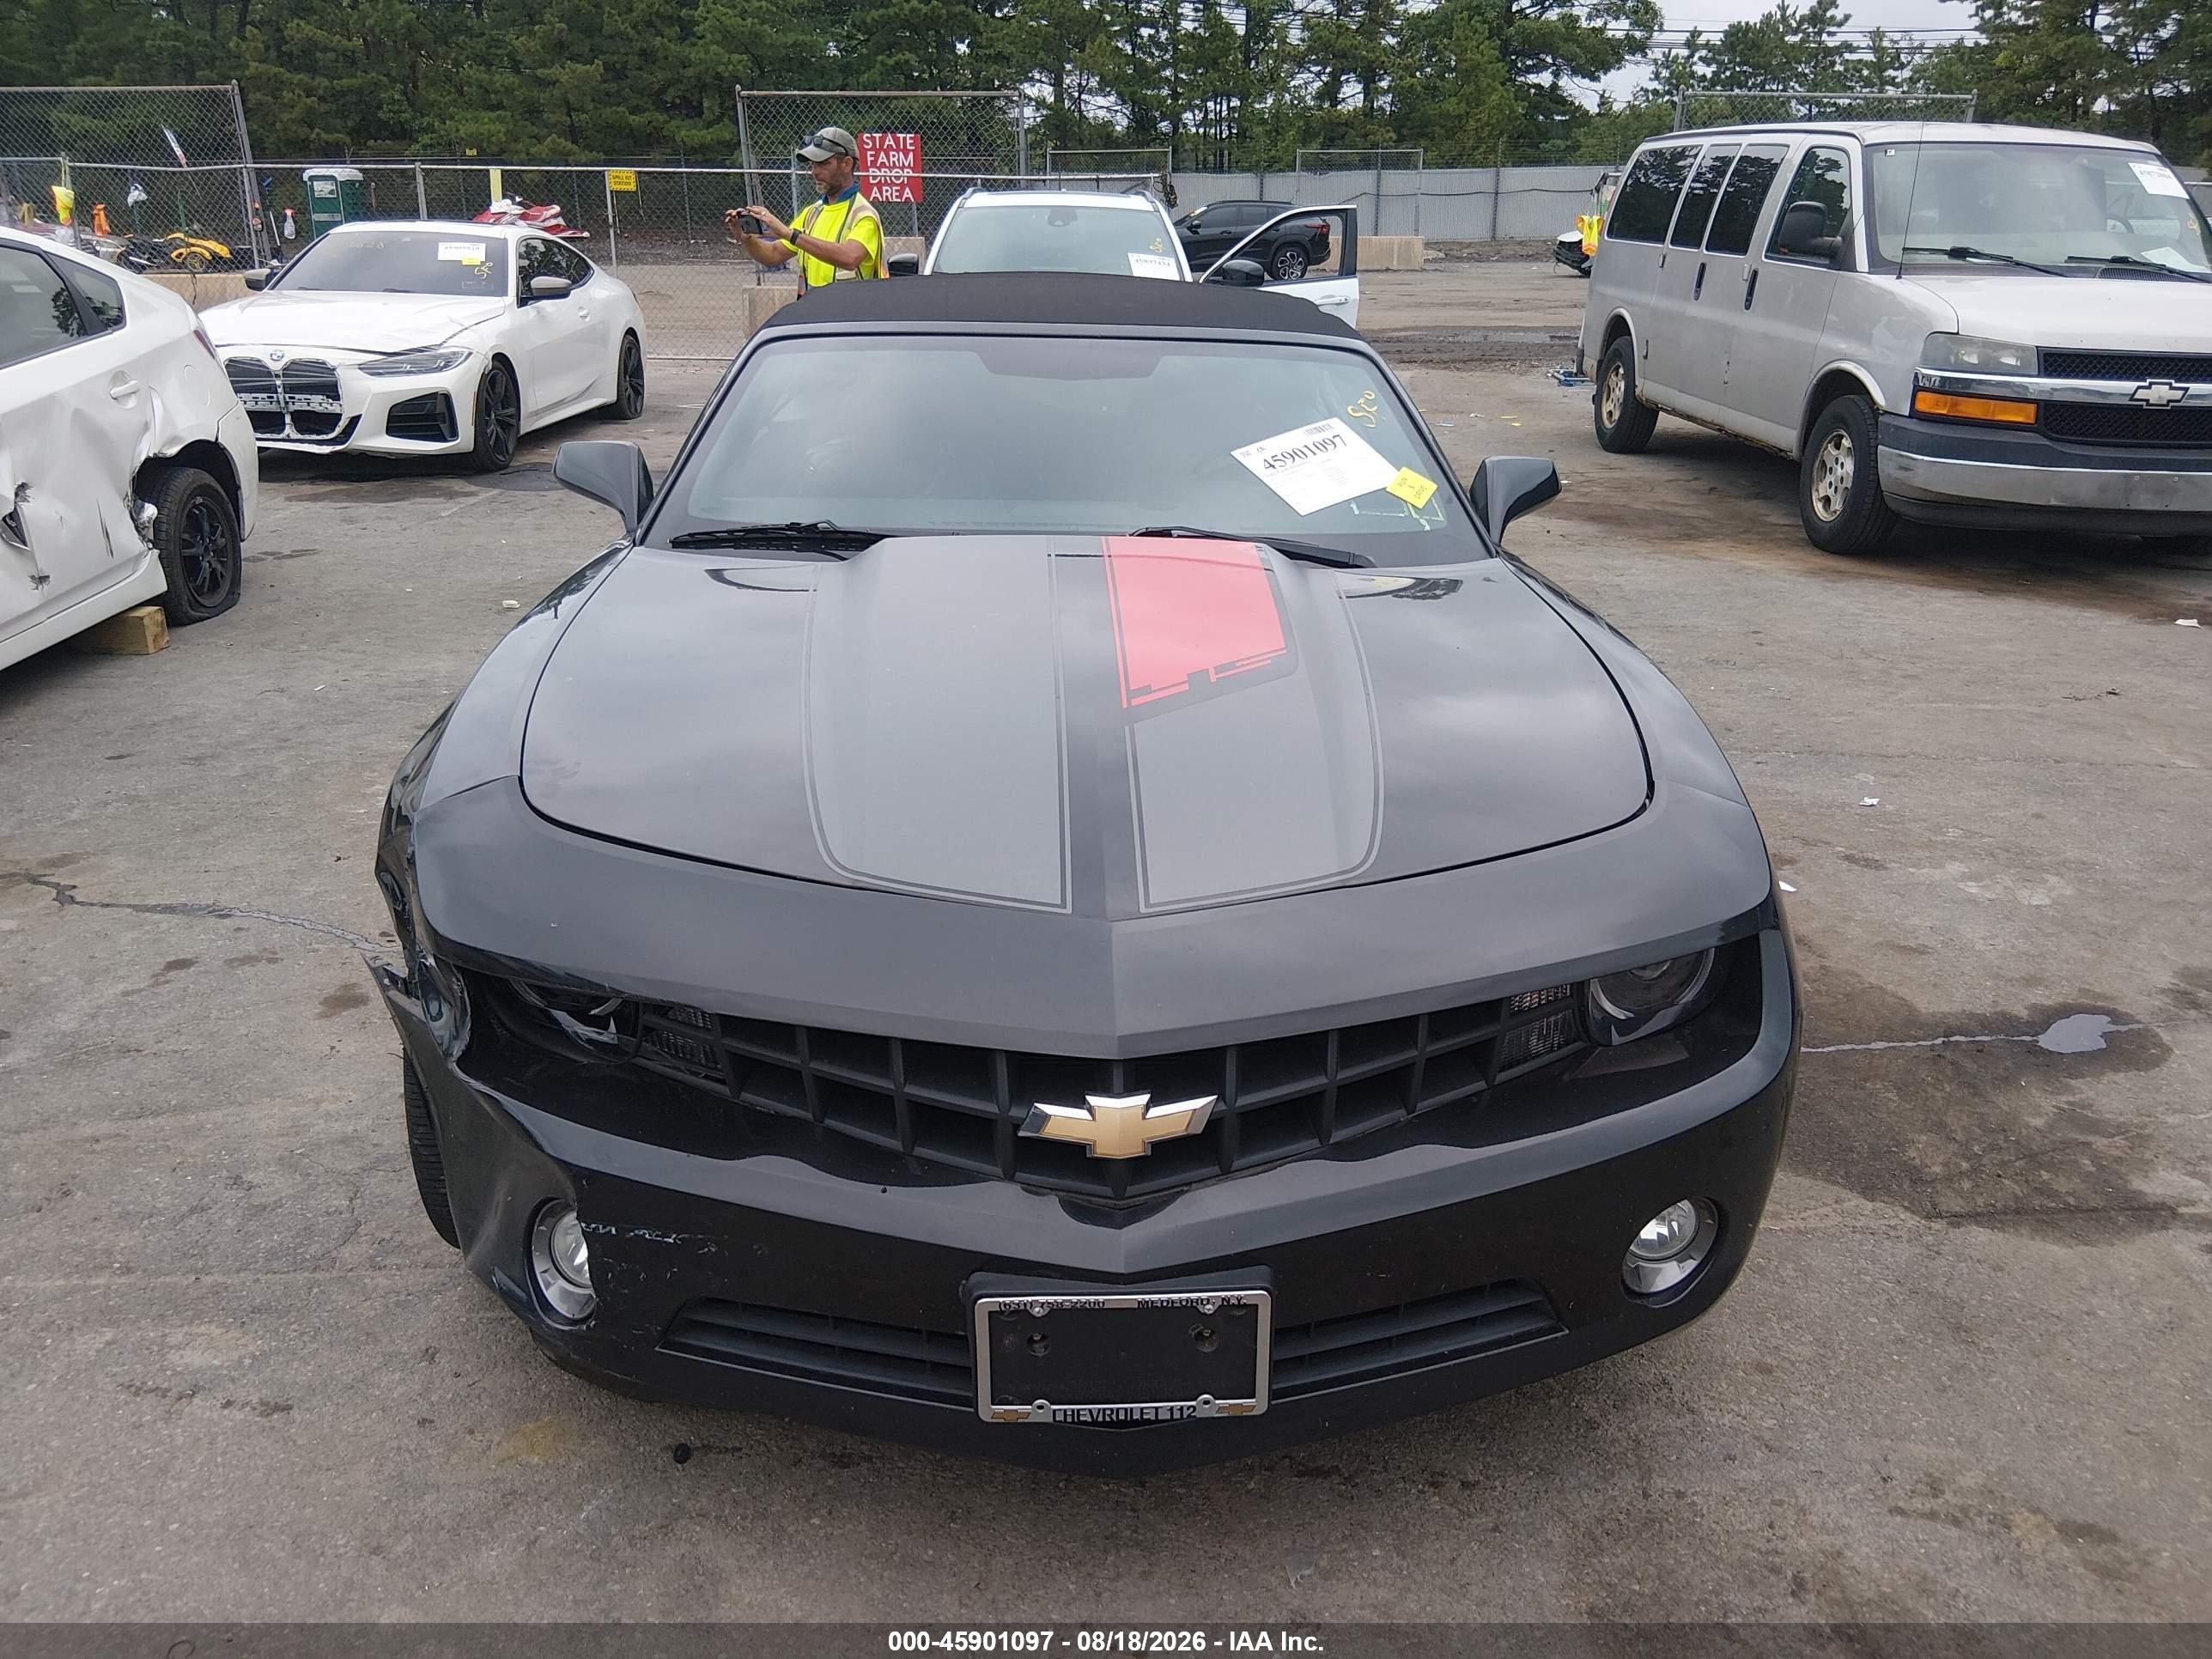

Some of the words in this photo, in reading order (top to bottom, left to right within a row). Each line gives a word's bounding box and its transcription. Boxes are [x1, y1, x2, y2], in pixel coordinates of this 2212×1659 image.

[863, 133, 915, 149] STATE
[866, 151, 914, 167] FARM
[869, 168, 913, 185] DROP
[870, 186, 915, 202] AREA
[1263, 434, 1347, 470] 45901097
[1053, 1407, 1159, 1422] CHEVROLET
[1167, 1405, 1197, 1419] 112
